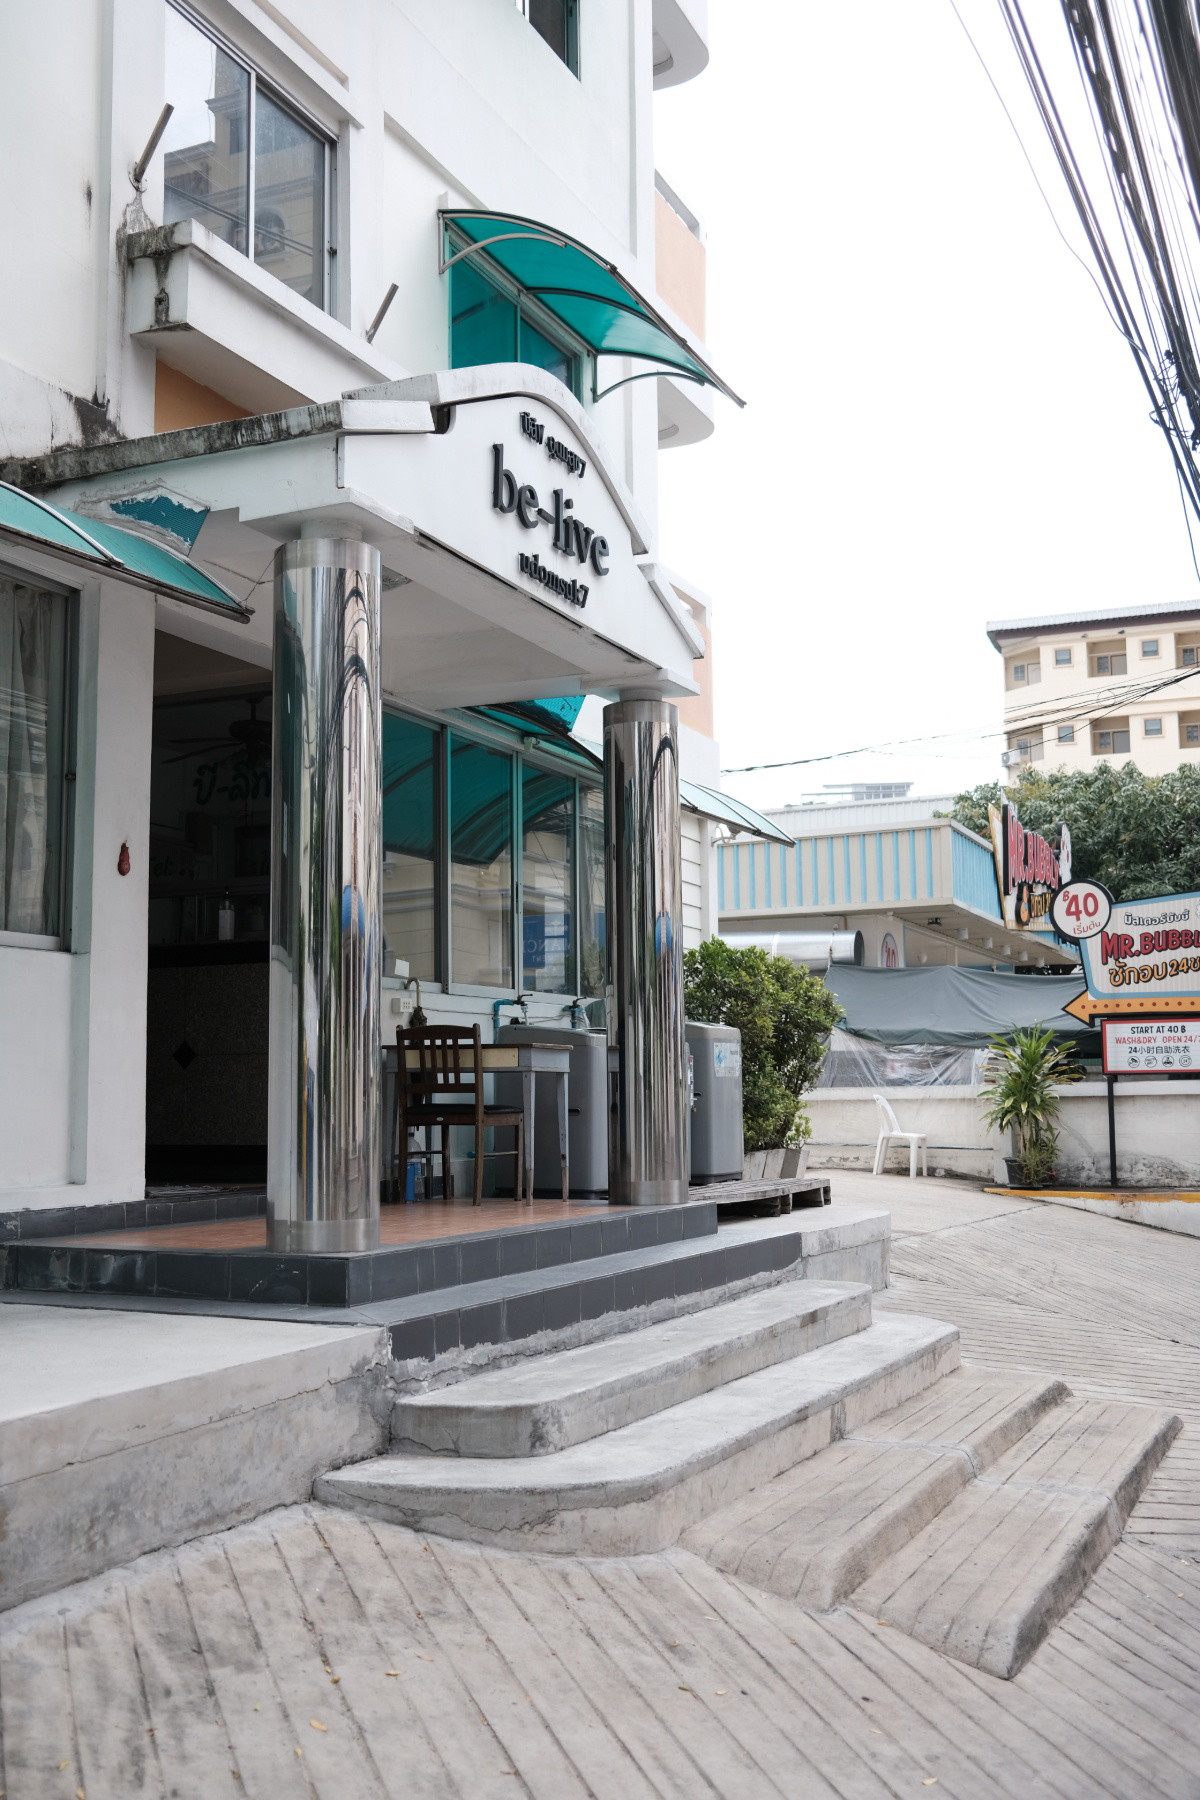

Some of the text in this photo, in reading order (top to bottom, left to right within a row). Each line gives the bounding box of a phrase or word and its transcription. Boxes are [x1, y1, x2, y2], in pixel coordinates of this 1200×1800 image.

[492, 443, 609, 576] be-live
[1130, 1026, 1154, 1035] START
[1156, 1025, 1166, 1034] AT
[1167, 1025, 1179, 1033] 40
[1114, 1036, 1157, 1045] WASH&DRY
[1162, 1035, 1182, 1044] OPEN
